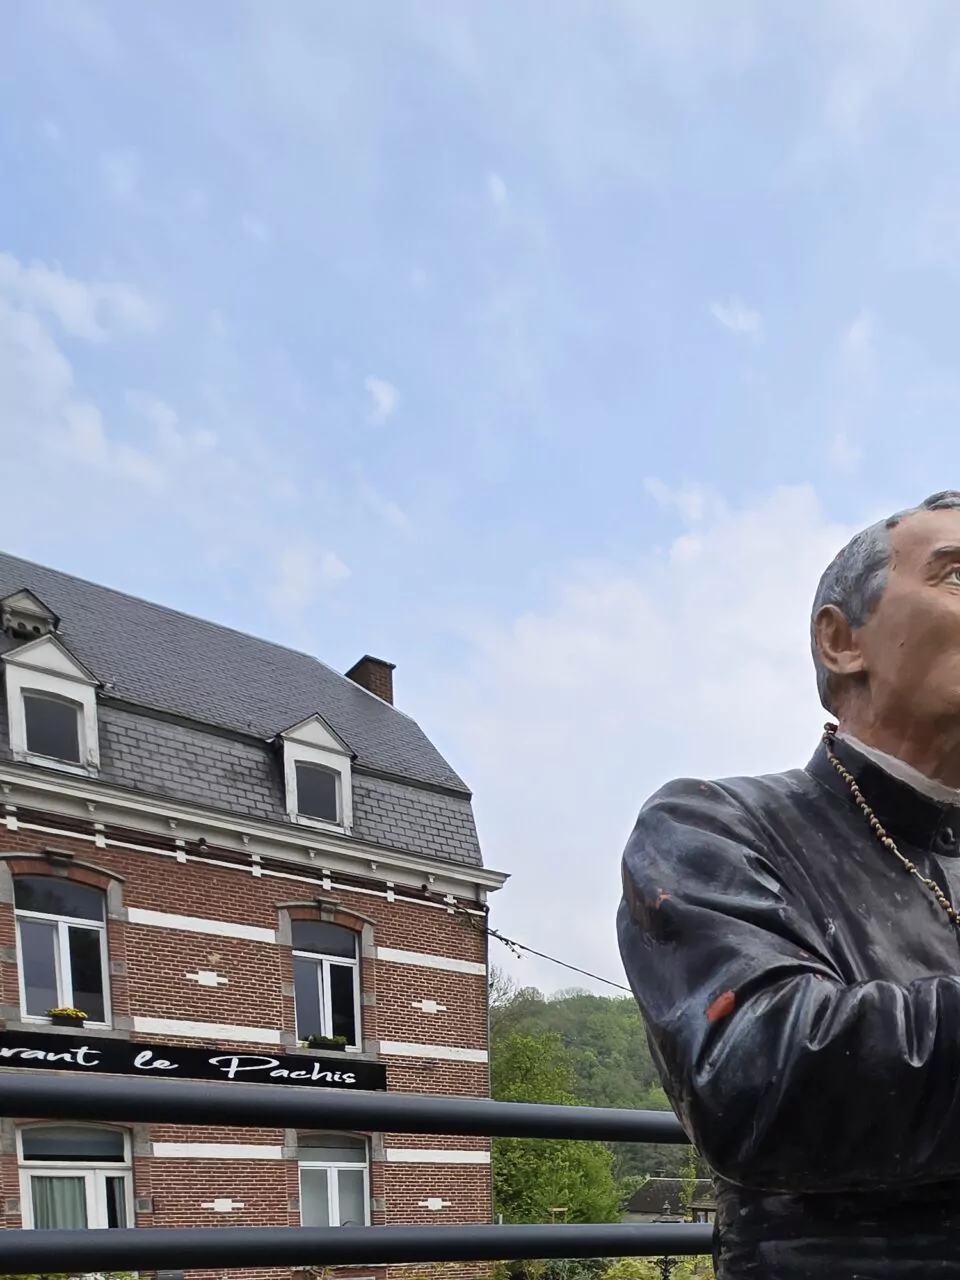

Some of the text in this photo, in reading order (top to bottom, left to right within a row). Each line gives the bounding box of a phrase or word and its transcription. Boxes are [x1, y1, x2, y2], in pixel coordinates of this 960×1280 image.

[0, 1046, 357, 1084] rant le Pachis
